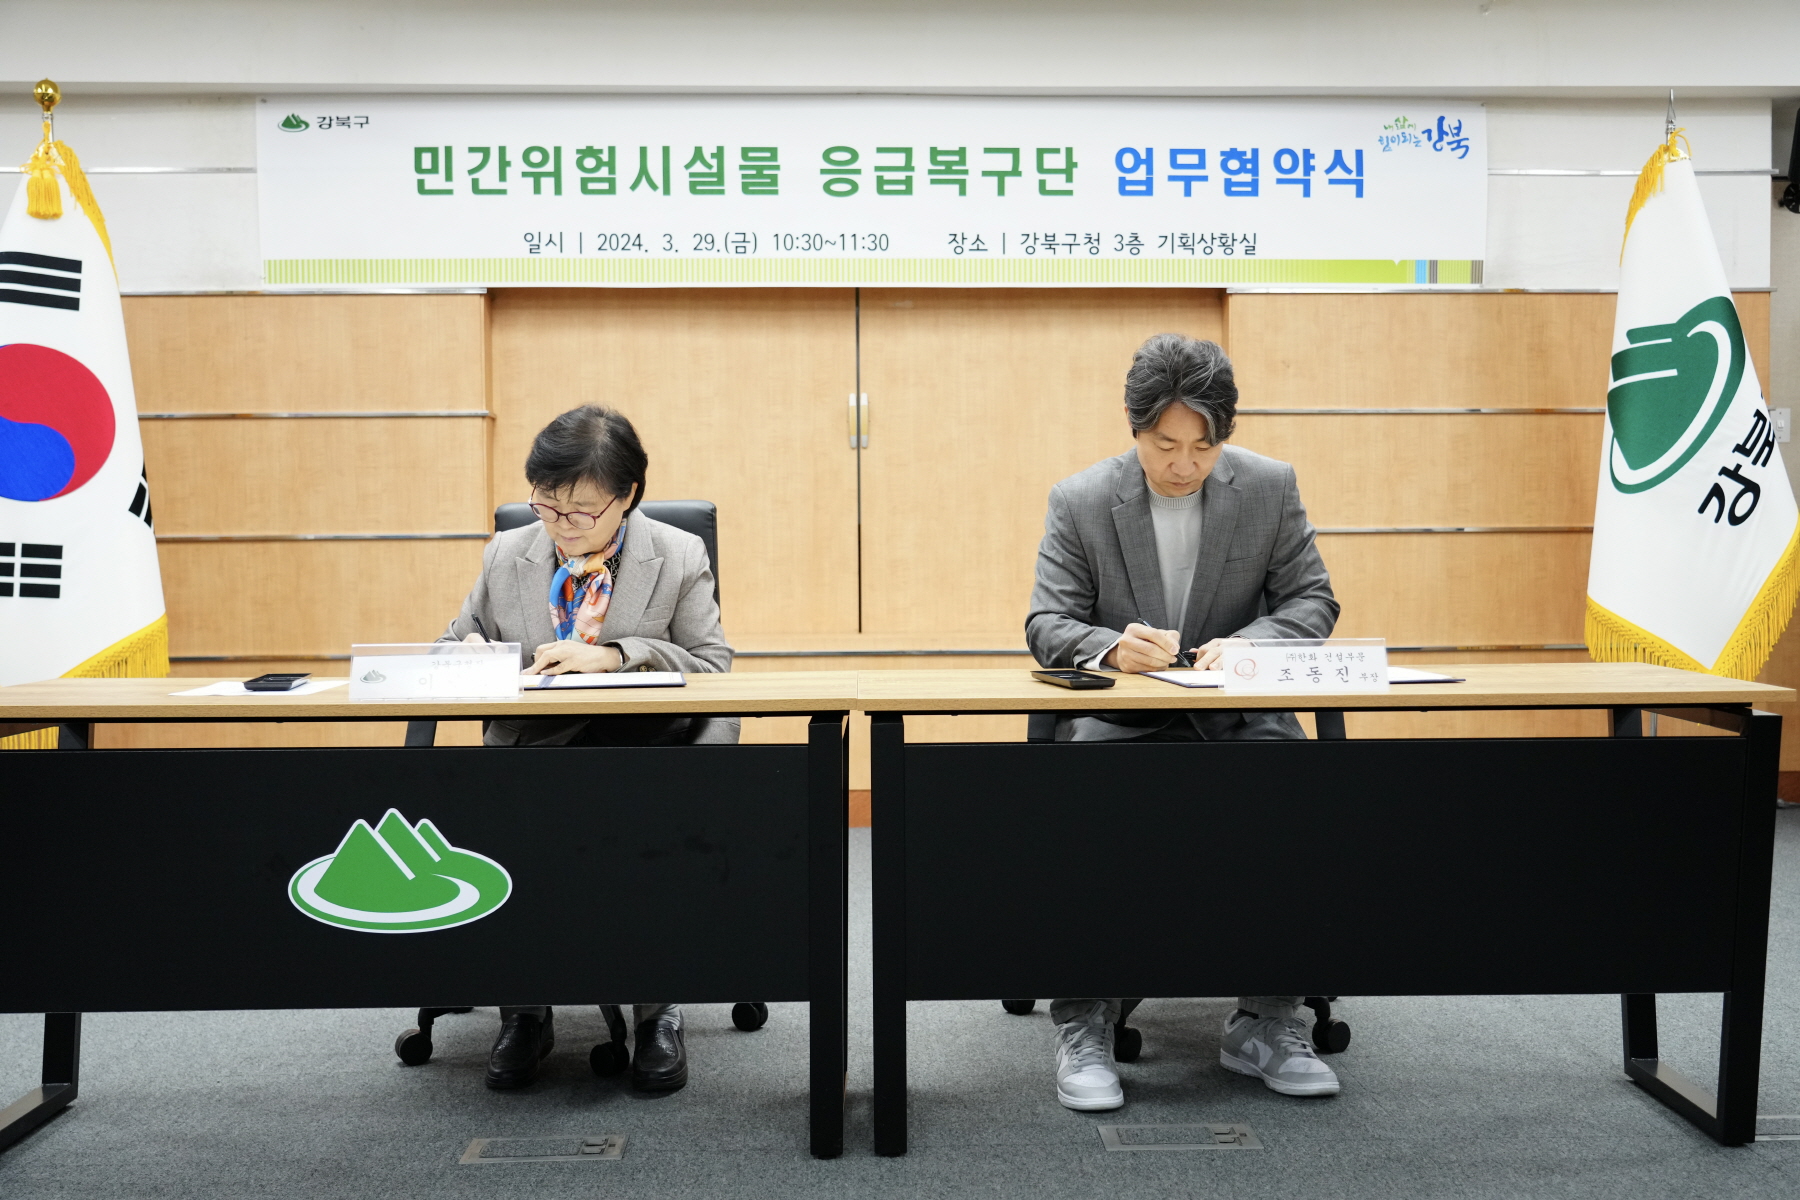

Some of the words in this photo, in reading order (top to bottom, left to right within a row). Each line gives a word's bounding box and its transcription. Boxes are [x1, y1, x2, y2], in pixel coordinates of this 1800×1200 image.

[316, 115, 370, 130] 강북구
[1421, 115, 1470, 160] 강북
[412, 145, 781, 197] 민간위험시설물
[819, 145, 1079, 198] 응급복구단
[1114, 146, 1365, 199] 업무협약식
[523, 231, 564, 255] 일시
[597, 232, 649, 253] 2024.
[662, 233, 679, 253] 3.
[692, 231, 758, 255] 29.(금)
[773, 233, 890, 253] 10:30~11:30
[947, 231, 989, 256] 장소
[1020, 231, 1101, 256] 강북구청
[1113, 232, 1145, 256] 3층
[1157, 232, 1258, 256] 기획상황실
[1697, 388, 1777, 527] 강북
